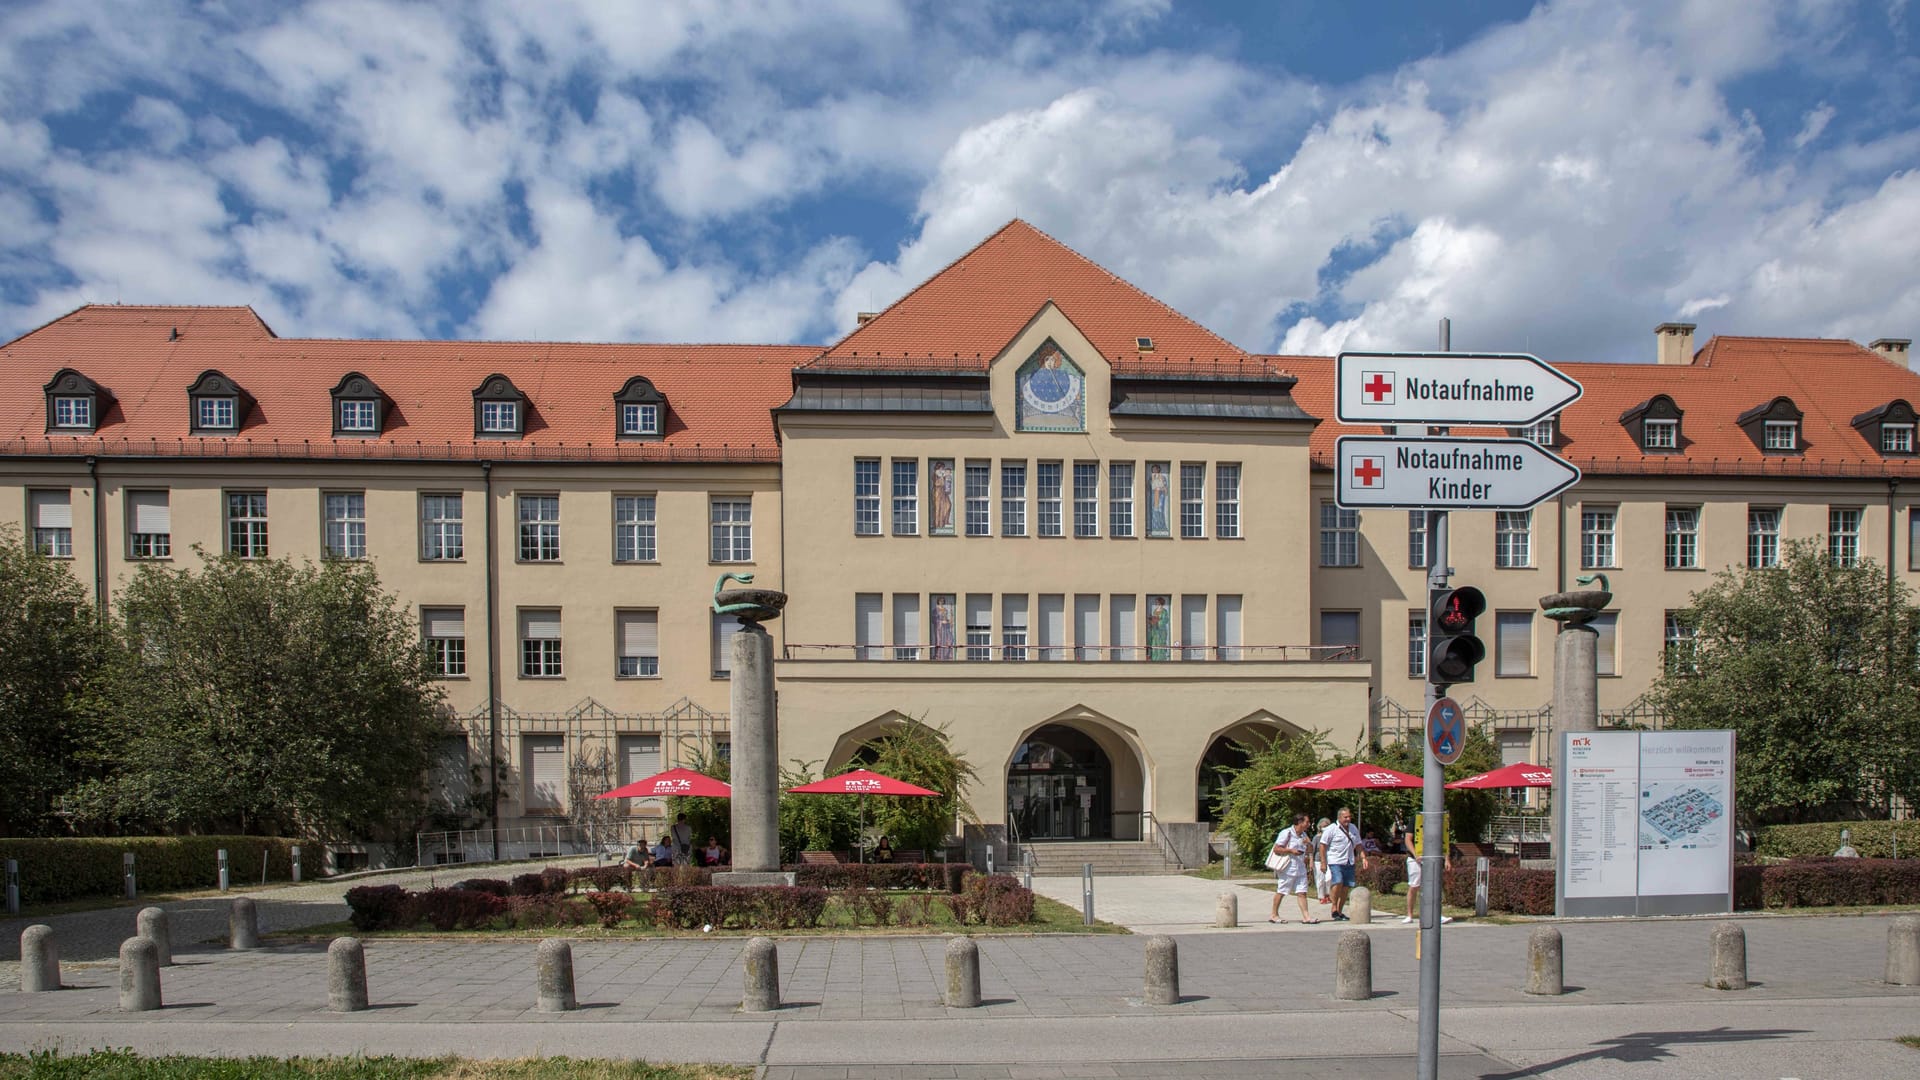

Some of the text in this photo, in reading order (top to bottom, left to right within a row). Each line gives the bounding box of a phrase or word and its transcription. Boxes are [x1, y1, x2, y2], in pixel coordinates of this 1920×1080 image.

[1406, 377, 1534, 402] Notaufnahme
[1396, 446, 1523, 471] Notaufnahme
[1429, 477, 1492, 500] Kinder
